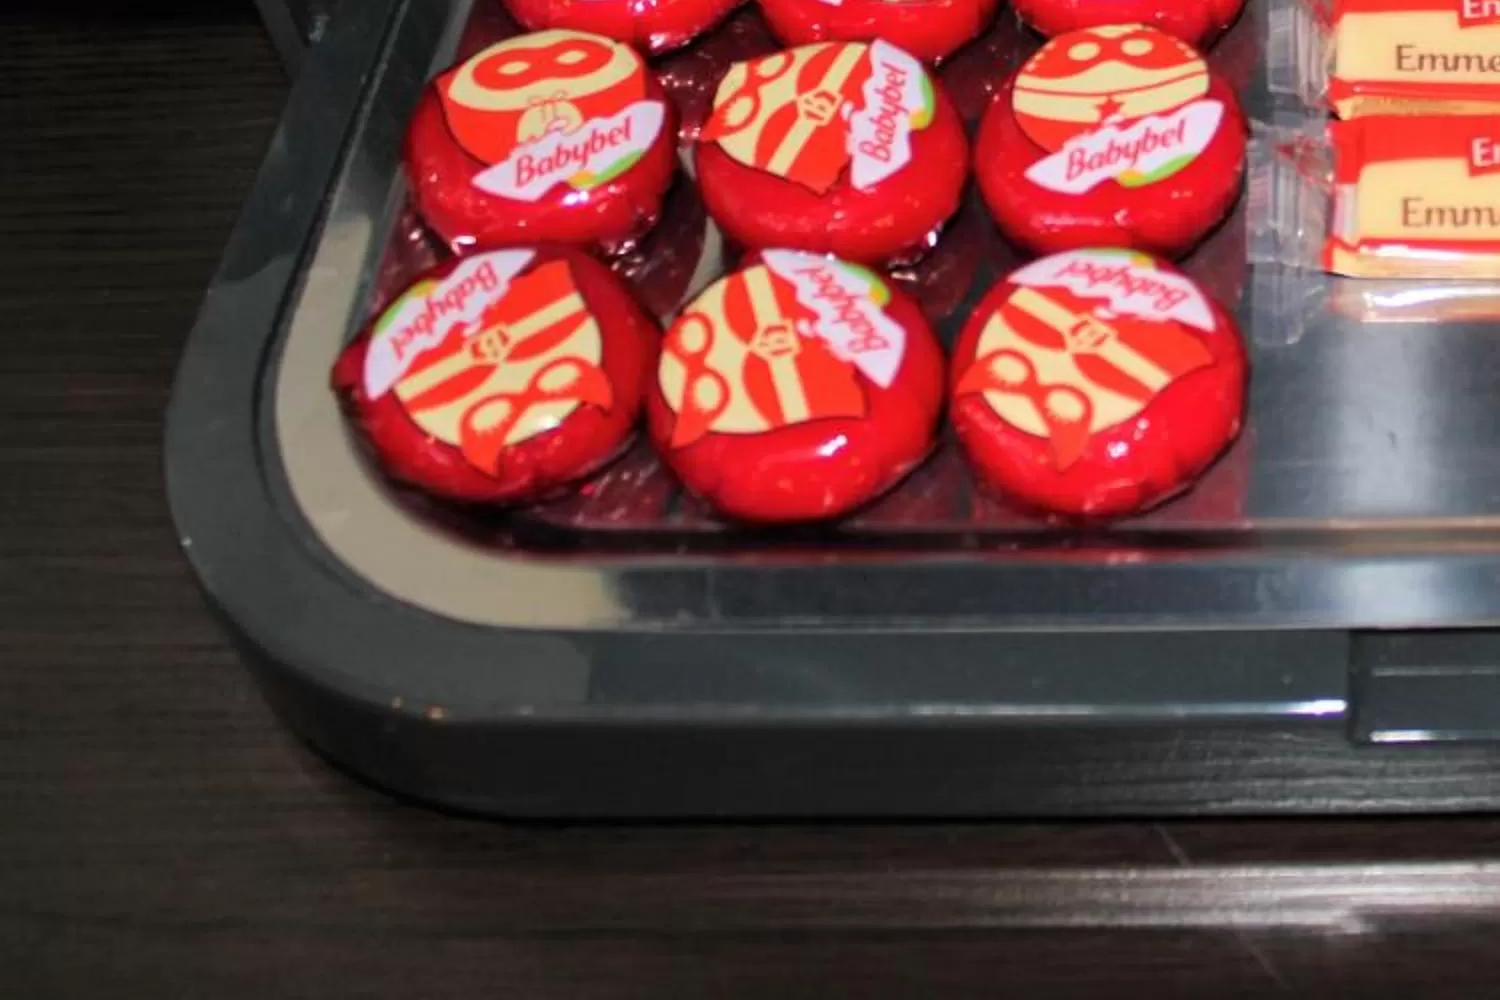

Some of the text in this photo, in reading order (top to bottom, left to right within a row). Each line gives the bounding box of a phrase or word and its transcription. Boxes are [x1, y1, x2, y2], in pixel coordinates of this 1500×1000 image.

[859, 60, 909, 162] Babybel
[1065, 118, 1186, 181] Babybel
[515, 115, 632, 187] Babybel
[389, 261, 497, 361] Babybel
[794, 266, 891, 353] Babybel
[1054, 260, 1190, 311] Babybel
